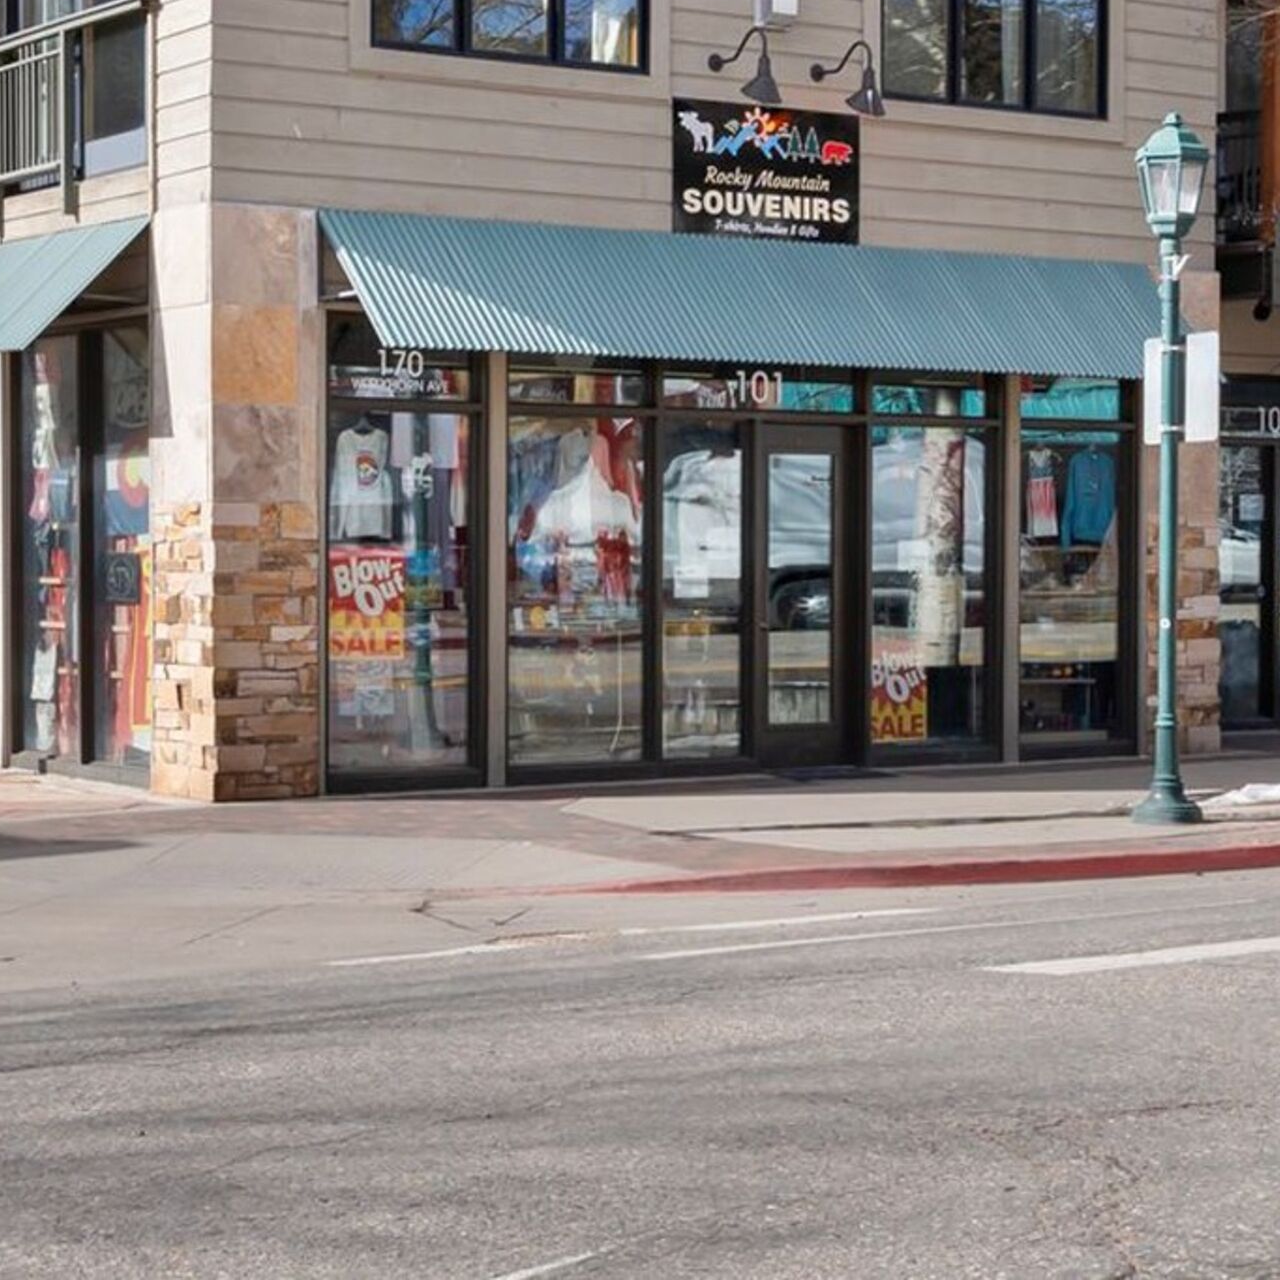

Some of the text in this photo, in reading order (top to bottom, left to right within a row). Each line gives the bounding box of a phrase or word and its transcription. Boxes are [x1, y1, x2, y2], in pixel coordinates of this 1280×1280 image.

[704, 165, 831, 192] Rocky Mountain
[683, 188, 851, 224] SOUVENIRS
[378, 349, 424, 378] 170
[736, 370, 783, 405] 101
[333, 556, 403, 598] Blow-
[353, 571, 405, 616] Out
[331, 630, 401, 656] SALE
[885, 663, 927, 703] Out
[871, 714, 923, 738] SALE
